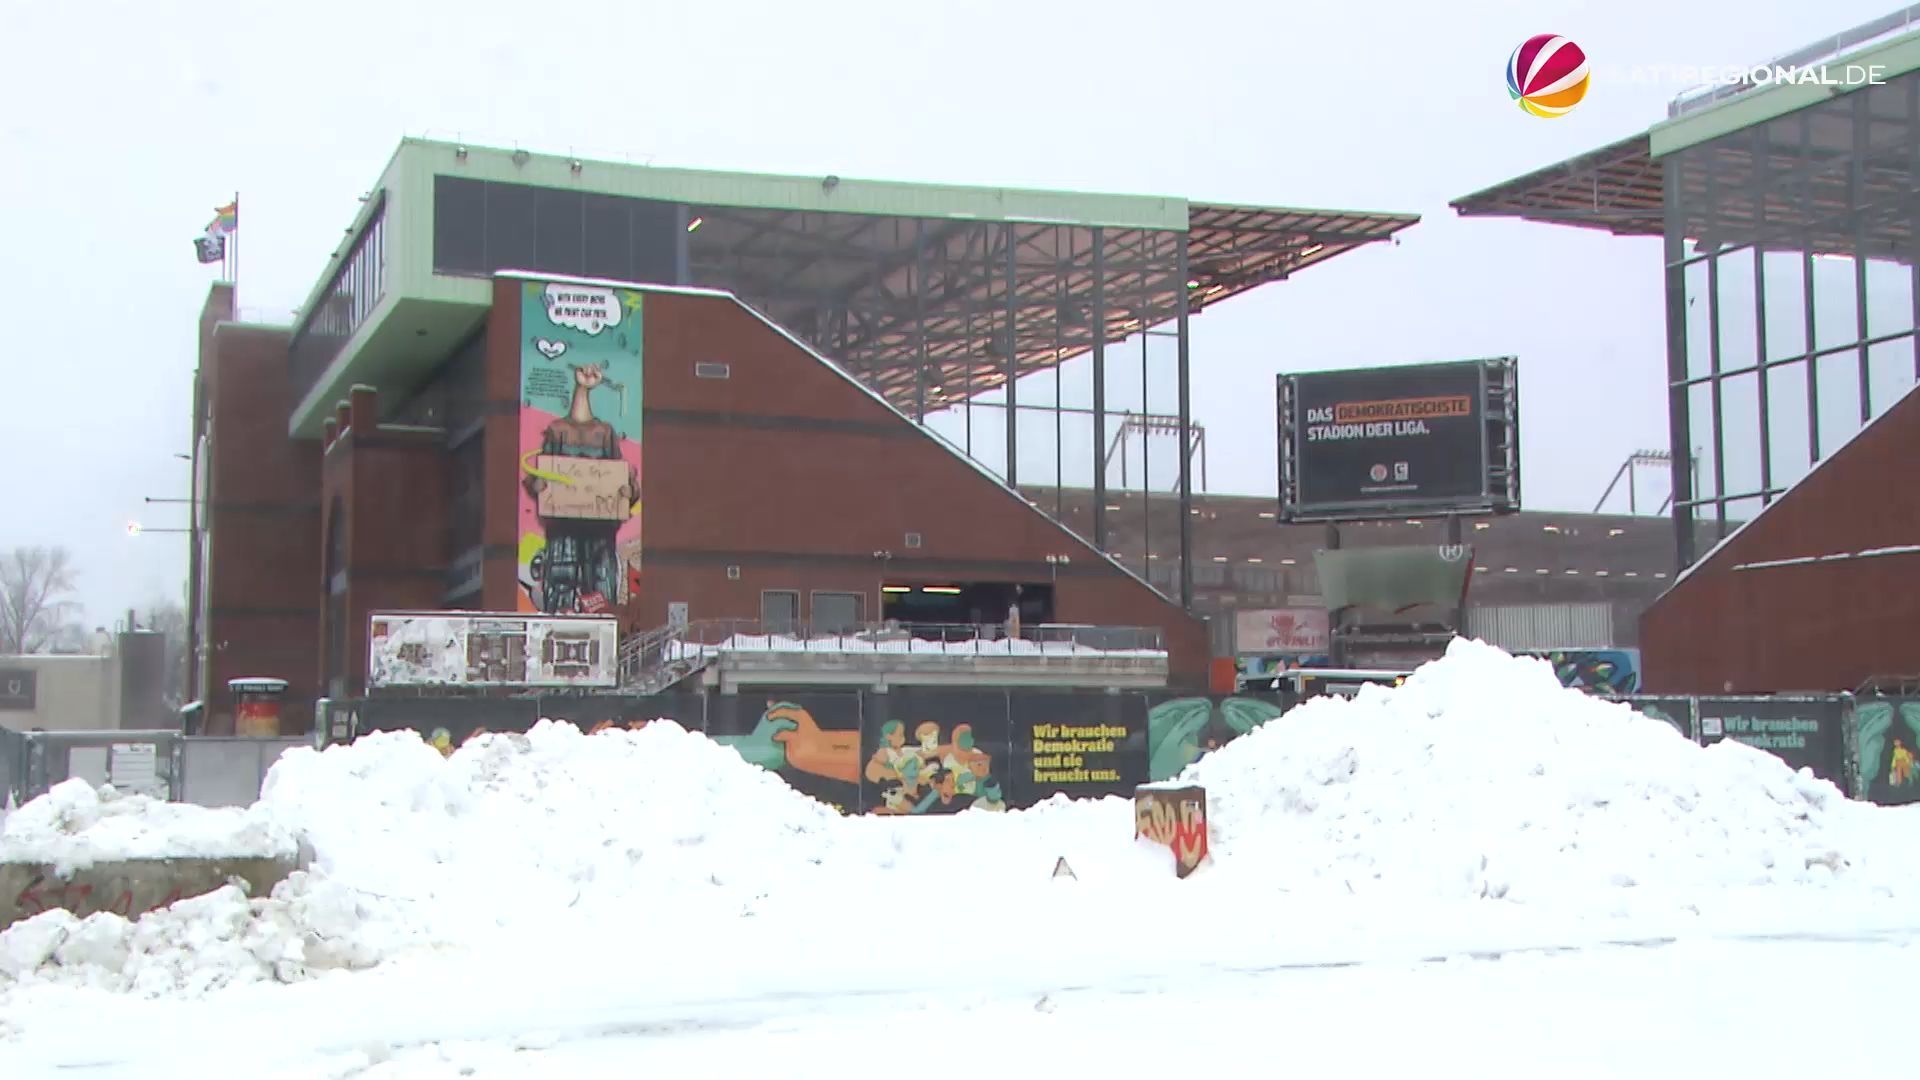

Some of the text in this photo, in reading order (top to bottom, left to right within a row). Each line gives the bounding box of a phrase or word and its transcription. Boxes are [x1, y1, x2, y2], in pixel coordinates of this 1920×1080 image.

[1307, 399, 1469, 423] DAS DEMOKRATISCHSTE
[1308, 420, 1430, 441] STADION DER LIGA.
[1033, 723, 1126, 738] Wir brauchen
[1724, 714, 1818, 732] Wir brauchen
[1033, 738, 1114, 753] Demokratie
[1735, 733, 1805, 749] mokratie
[1034, 753, 1082, 768] und sie
[1034, 768, 1120, 782] braucht uns.
